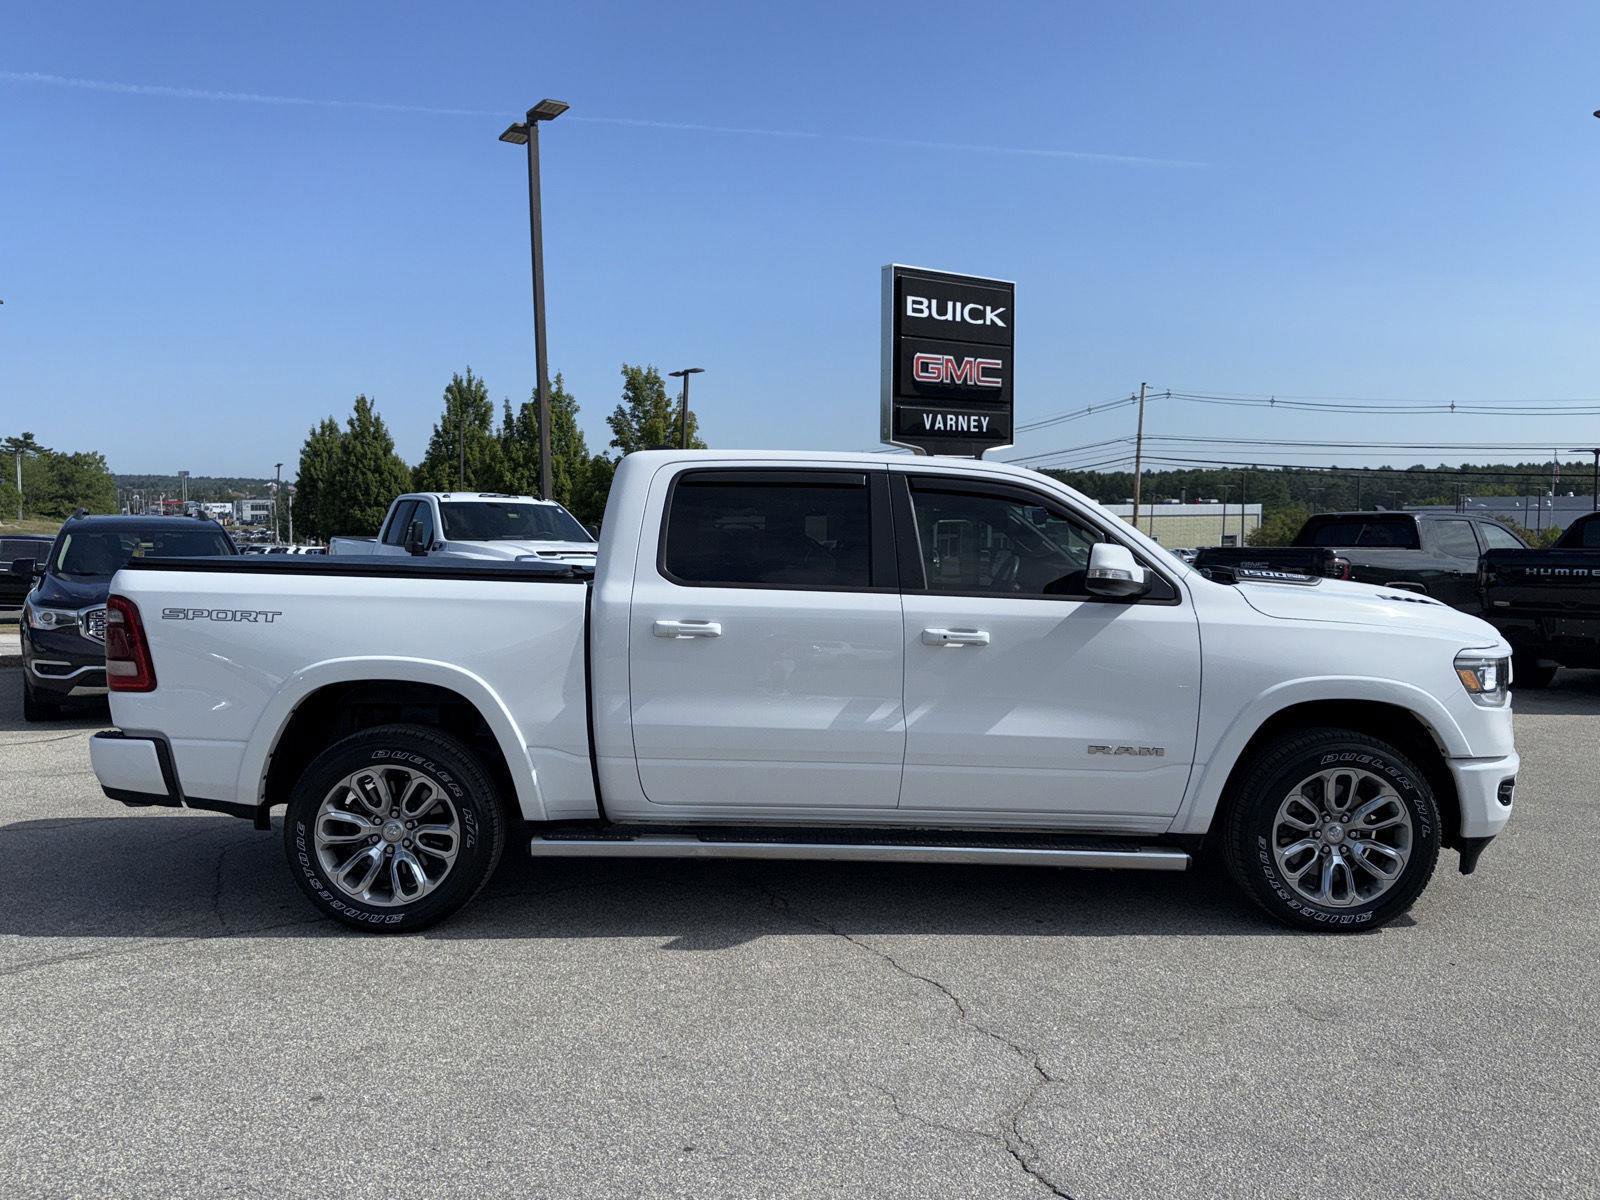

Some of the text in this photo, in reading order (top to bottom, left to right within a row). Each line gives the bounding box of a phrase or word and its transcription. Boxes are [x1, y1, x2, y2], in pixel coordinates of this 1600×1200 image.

[906, 295, 1007, 327] BUICK
[913, 352, 1002, 388] GMC
[923, 413, 989, 432] VARNEY
[1242, 568, 1287, 578] 1500
[161, 607, 282, 623] SPORT
[1087, 744, 1165, 757] RAM
[371, 749, 463, 797] DUELER
[1321, 752, 1413, 790] DUELER
[296, 820, 405, 924] BRIDGESTONE
[1257, 835, 1374, 924] BRIDGESTONE
